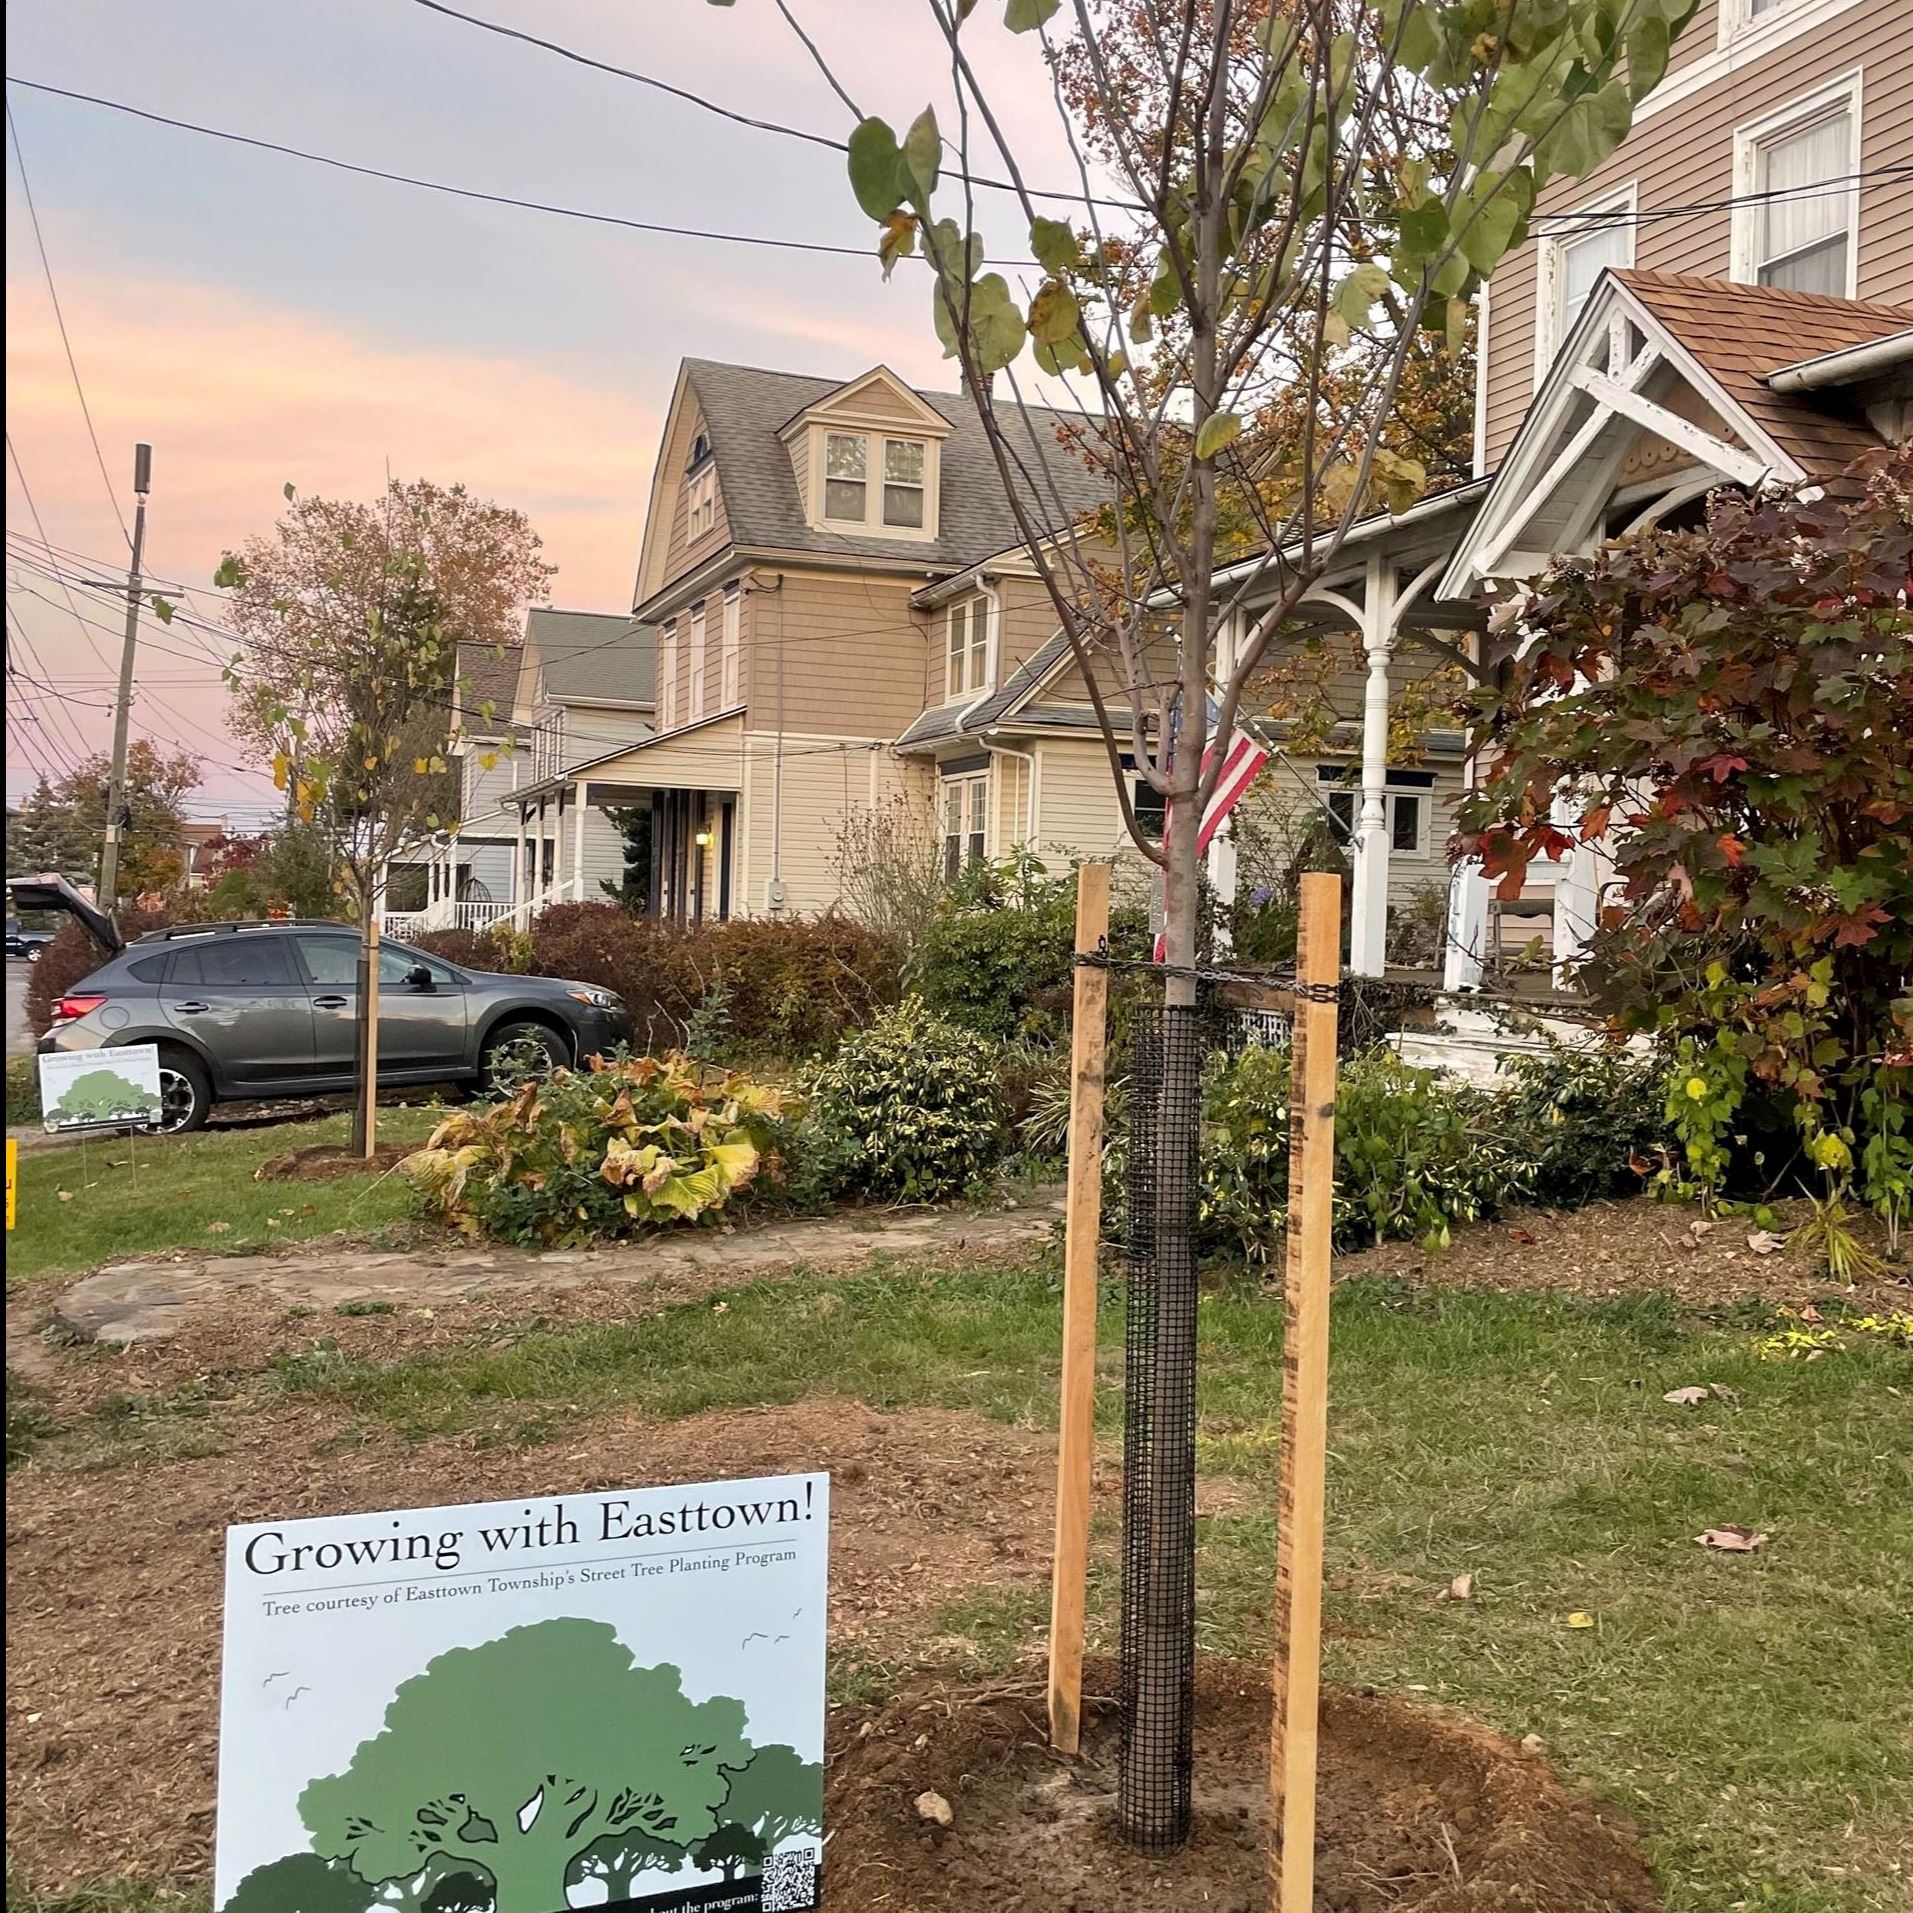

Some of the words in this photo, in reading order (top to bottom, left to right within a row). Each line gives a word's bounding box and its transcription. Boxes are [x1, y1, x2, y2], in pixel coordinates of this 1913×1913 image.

[245, 1521, 463, 1575] Growing
[478, 1503, 581, 1552] with
[598, 1481, 813, 1541] Easttown!
[263, 1601, 301, 1616] Tree
[306, 1595, 378, 1611] courtesy
[384, 1587, 402, 1604] of
[406, 1582, 482, 1601] Easttown
[488, 1568, 576, 1593] Township's
[580, 1567, 625, 1583] Street
[631, 1561, 664, 1577] Tree
[669, 1553, 731, 1573] Planting
[735, 1548, 797, 1568] Program
[681, 1901, 702, 1913] the
[703, 1893, 759, 1913] program:
